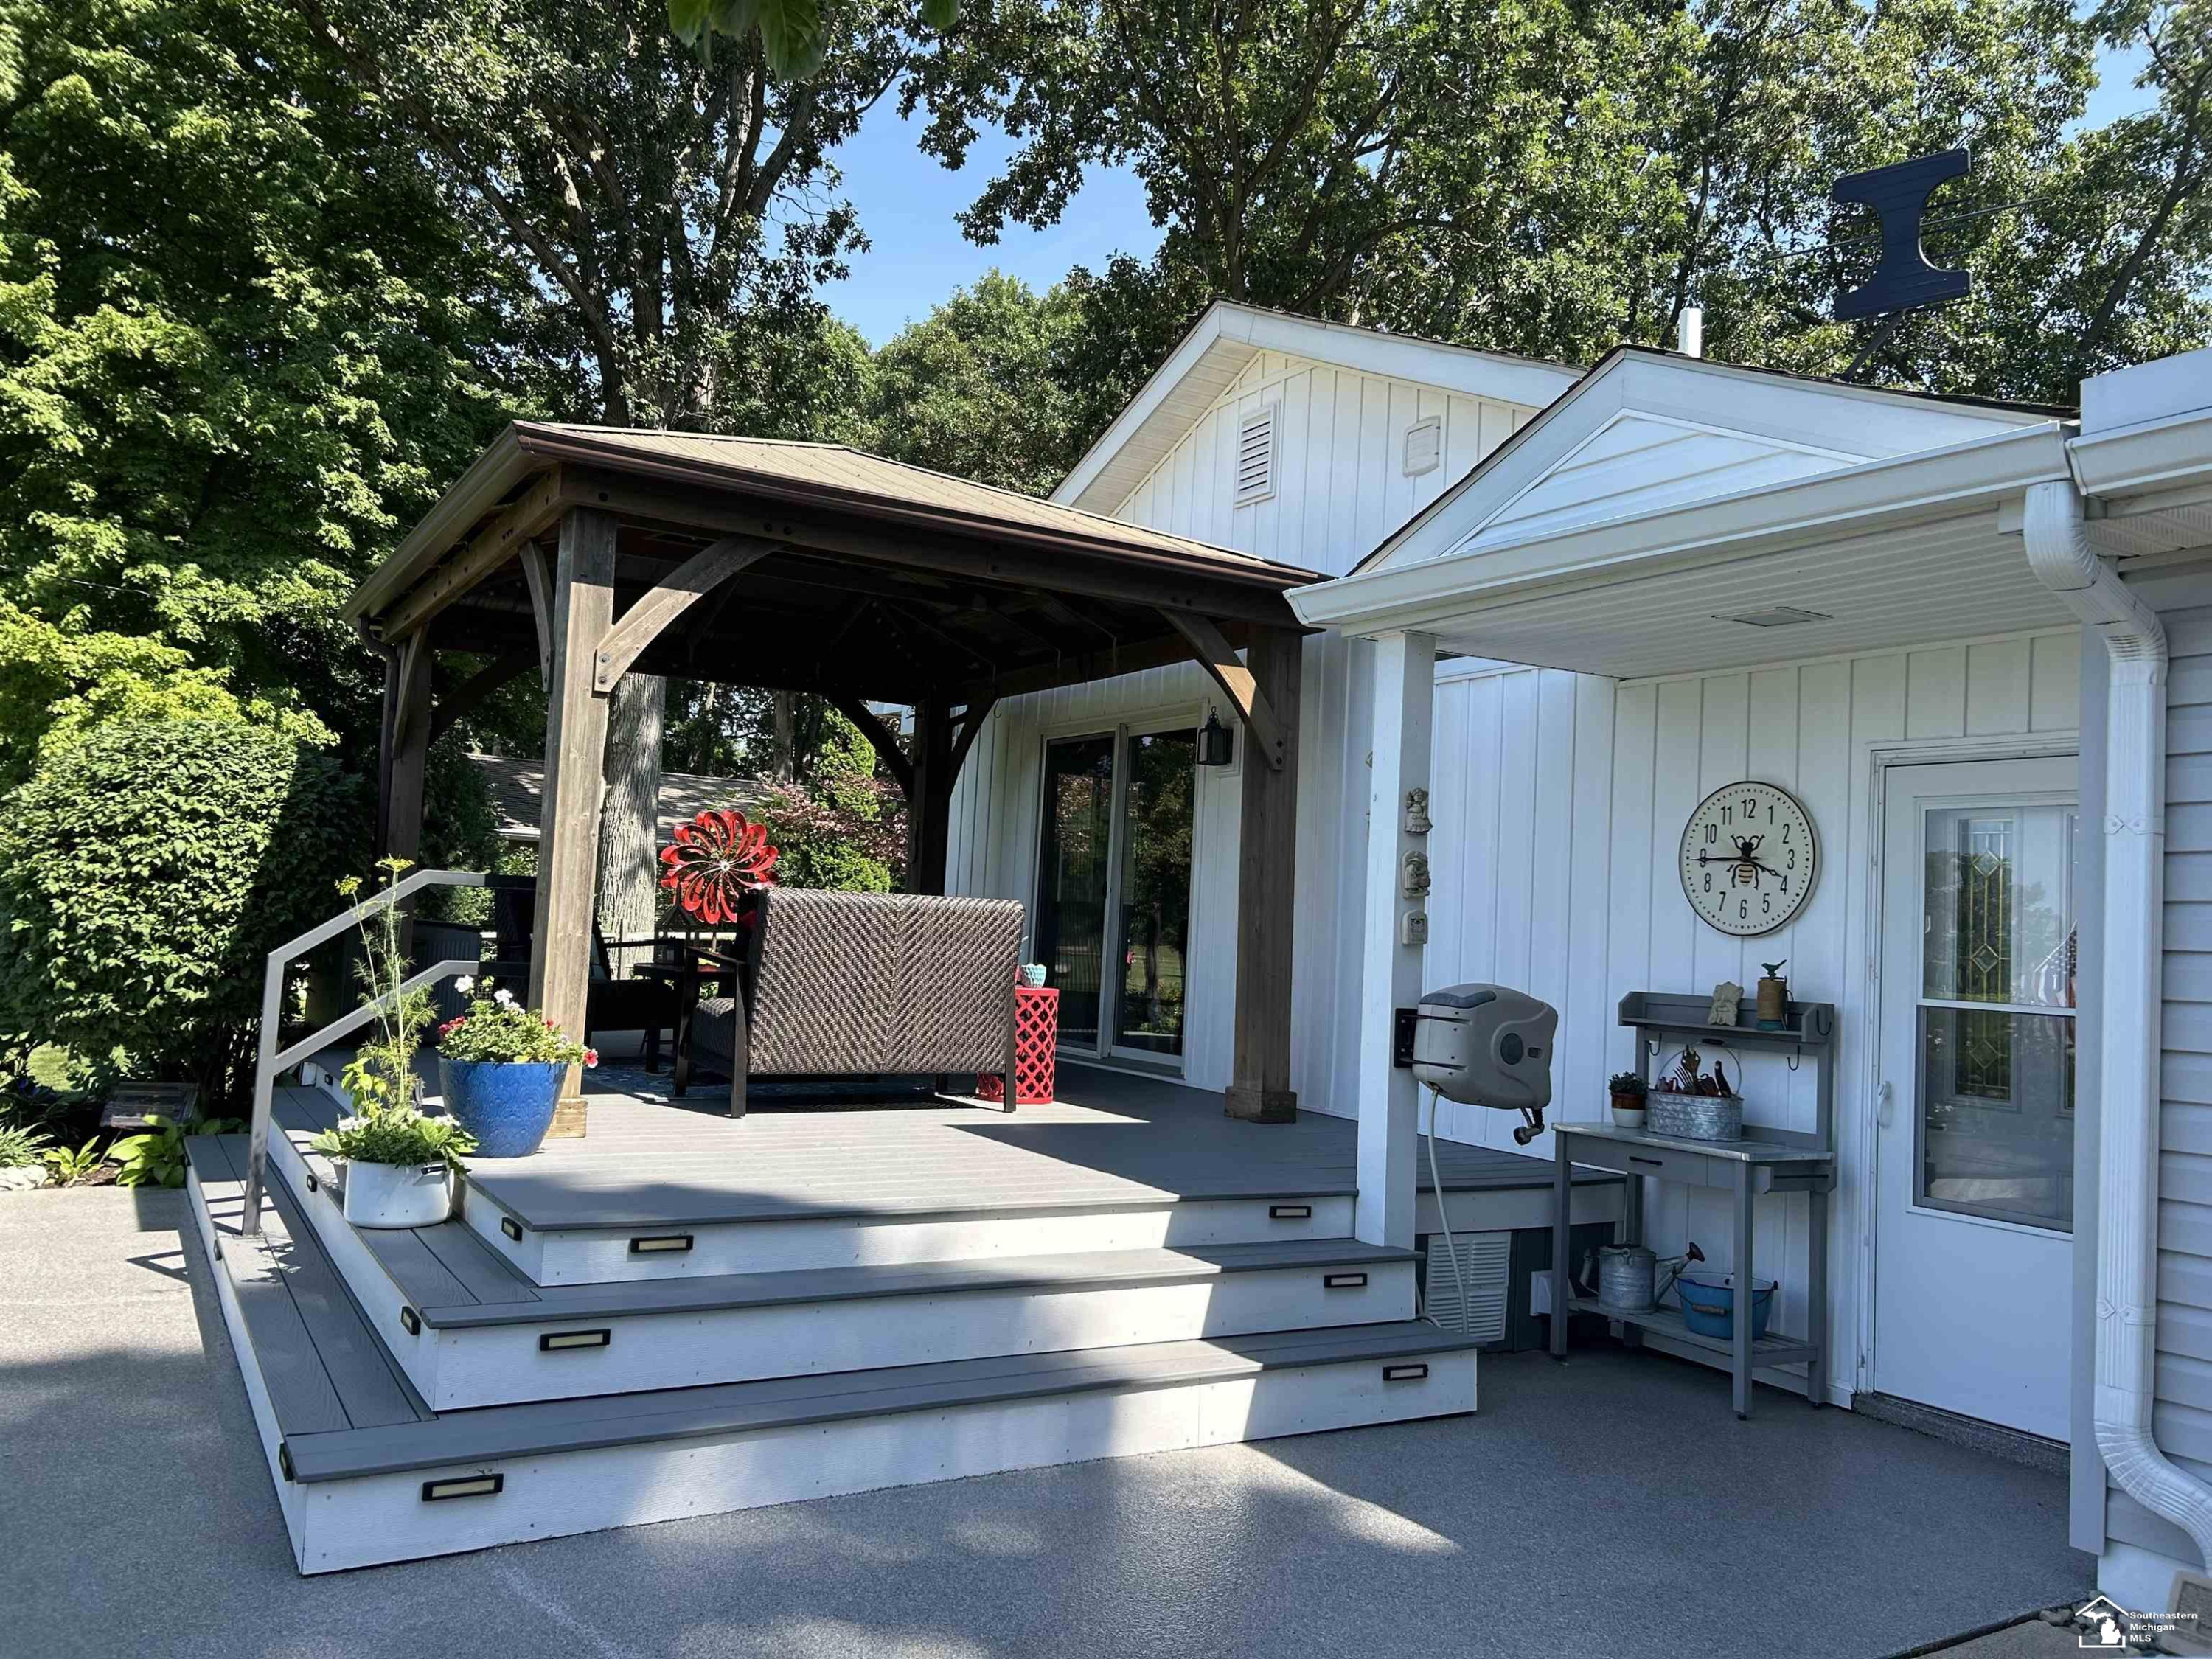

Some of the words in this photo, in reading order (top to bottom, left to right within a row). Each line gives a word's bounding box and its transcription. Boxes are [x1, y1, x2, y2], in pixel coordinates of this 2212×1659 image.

[1720, 806, 1732, 825] 11
[1741, 799, 1756, 818] 12
[1768, 805, 1773, 825] 1
[1703, 824, 1717, 844] 10
[1782, 824, 1790, 844] 2
[1700, 848, 1707, 868] 9
[1787, 849, 1795, 869] 3
[1704, 873, 1711, 893] 8
[1780, 875, 1787, 895] 4
[1719, 891, 1726, 911] 7
[1739, 899, 1747, 919] 6
[1762, 893, 1770, 913] 5
